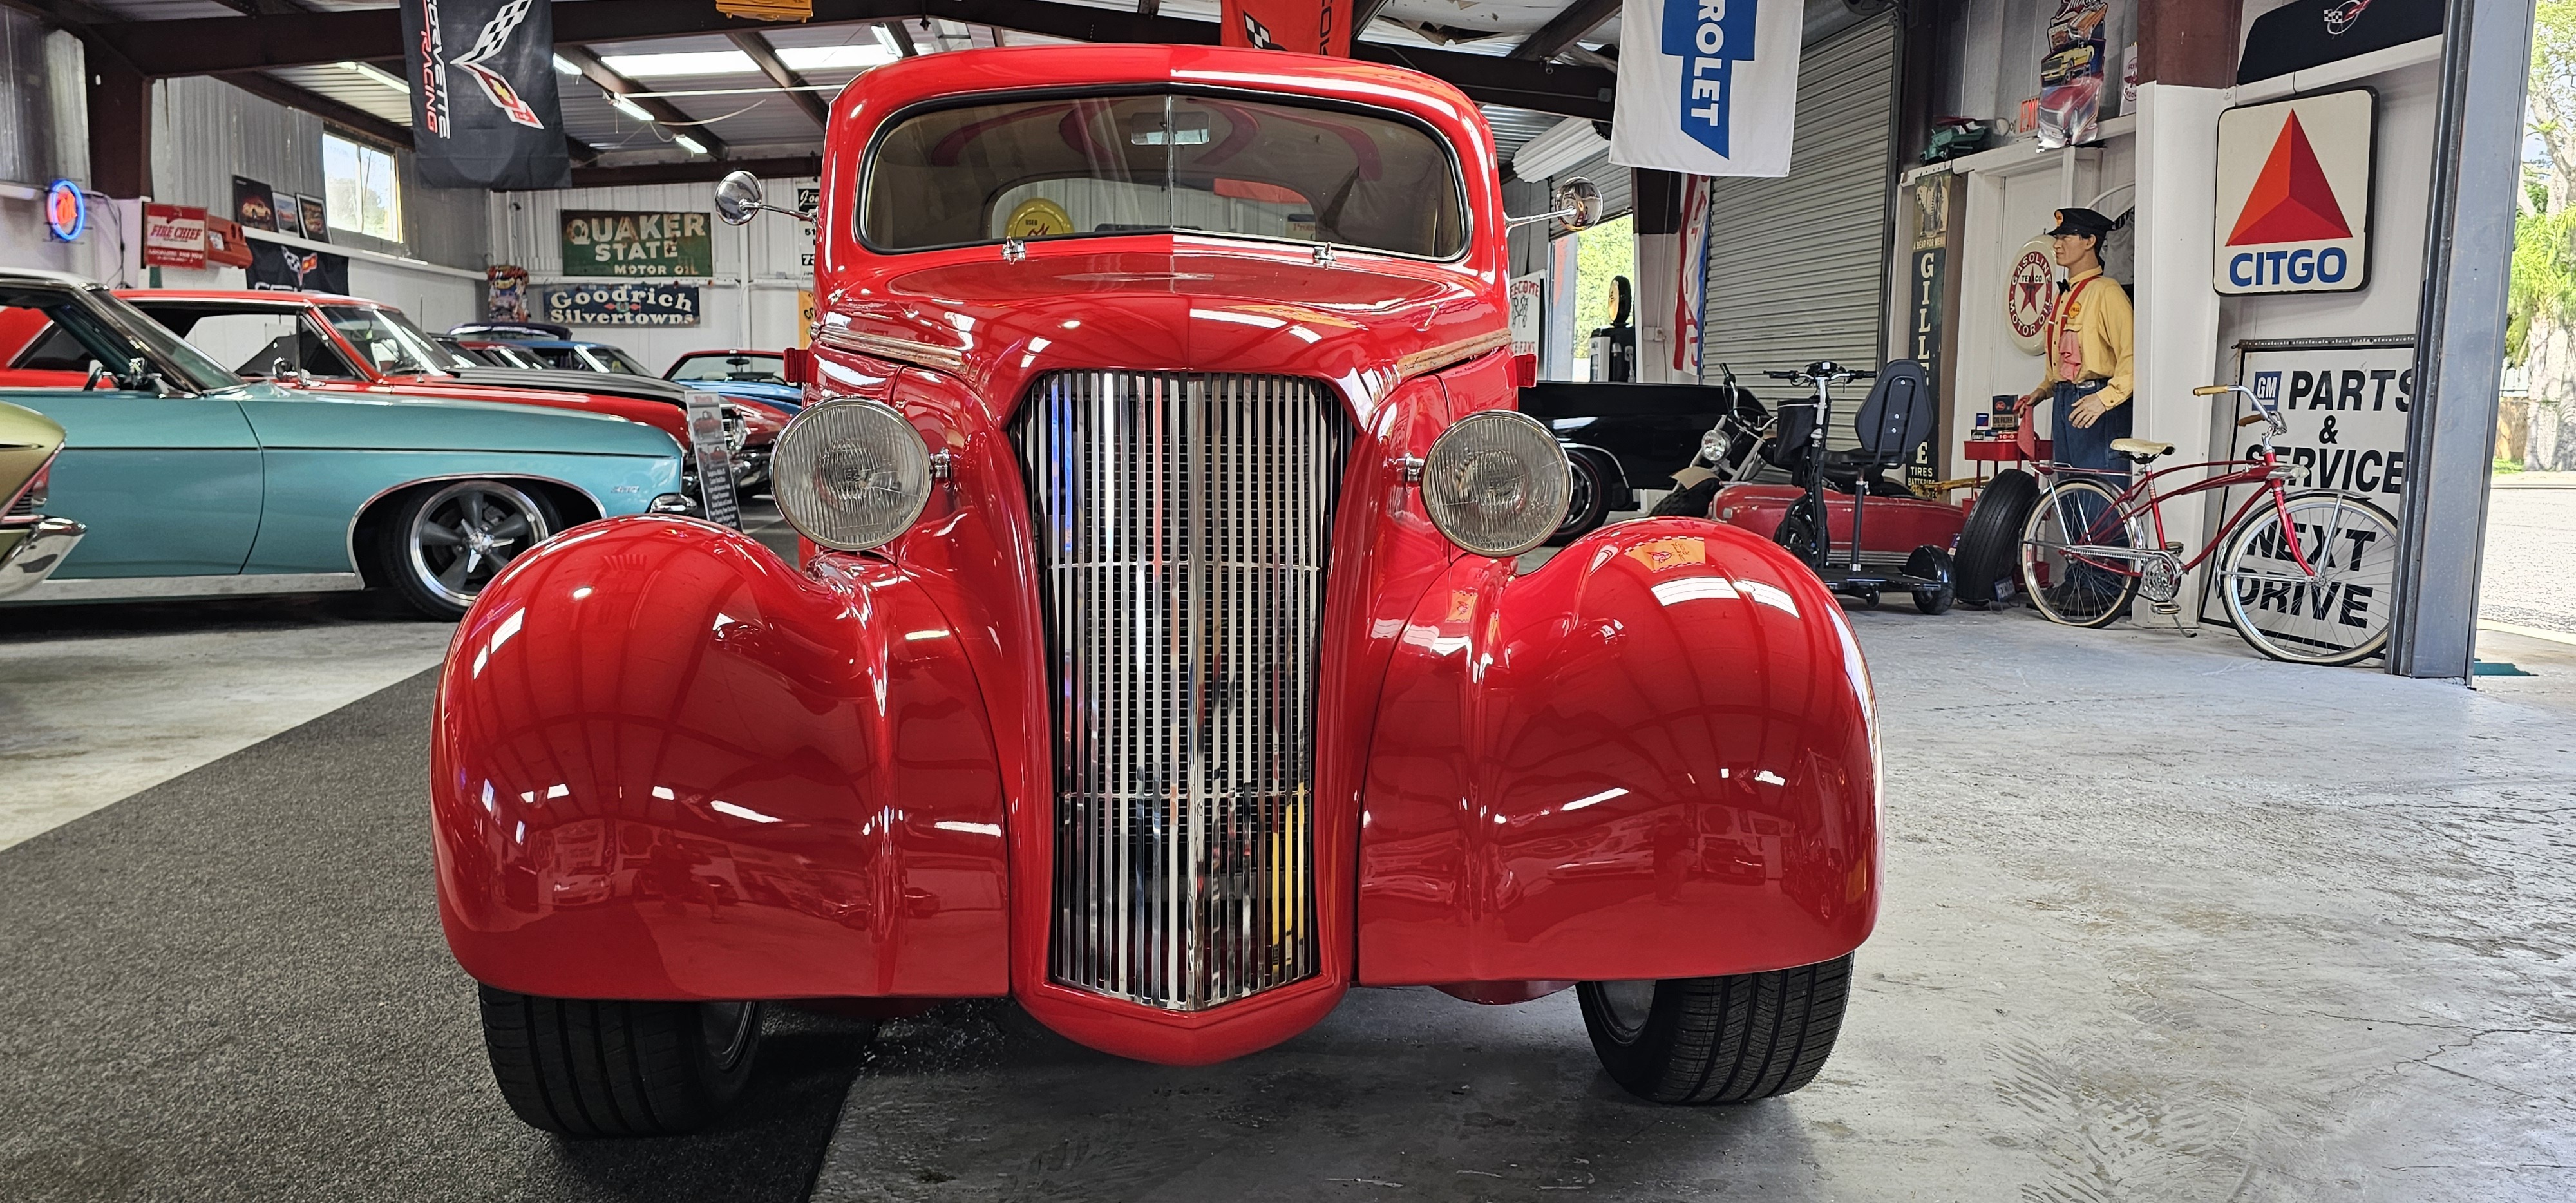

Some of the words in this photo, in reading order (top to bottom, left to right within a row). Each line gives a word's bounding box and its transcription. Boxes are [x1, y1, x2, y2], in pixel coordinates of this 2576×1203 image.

[427, 0, 450, 139] ORVETTE
[1691, 0, 1726, 126] ROLET
[421, 30, 438, 133] RACING
[150, 224, 175, 238] FIRE
[174, 226, 203, 240] CHIEF
[567, 213, 706, 245] QUAKER
[595, 240, 678, 261] STATE
[2229, 247, 2347, 287] CITGO
[614, 264, 667, 275] MOTOR
[674, 264, 699, 275] OIL
[2012, 252, 2052, 286] GASOLINE
[551, 285, 692, 312] Goodrich
[551, 309, 694, 325] Silvertowns
[2009, 299, 2036, 336] MOTOR
[2038, 298, 2052, 325] OIL
[2257, 377, 2277, 399] GM
[2288, 368, 2412, 412] PARTS
[2318, 415, 2338, 444] &
[1910, 466, 1933, 477] TIRES
[2246, 520, 2377, 572] NEXT
[2237, 567, 2374, 629] DRIVE
